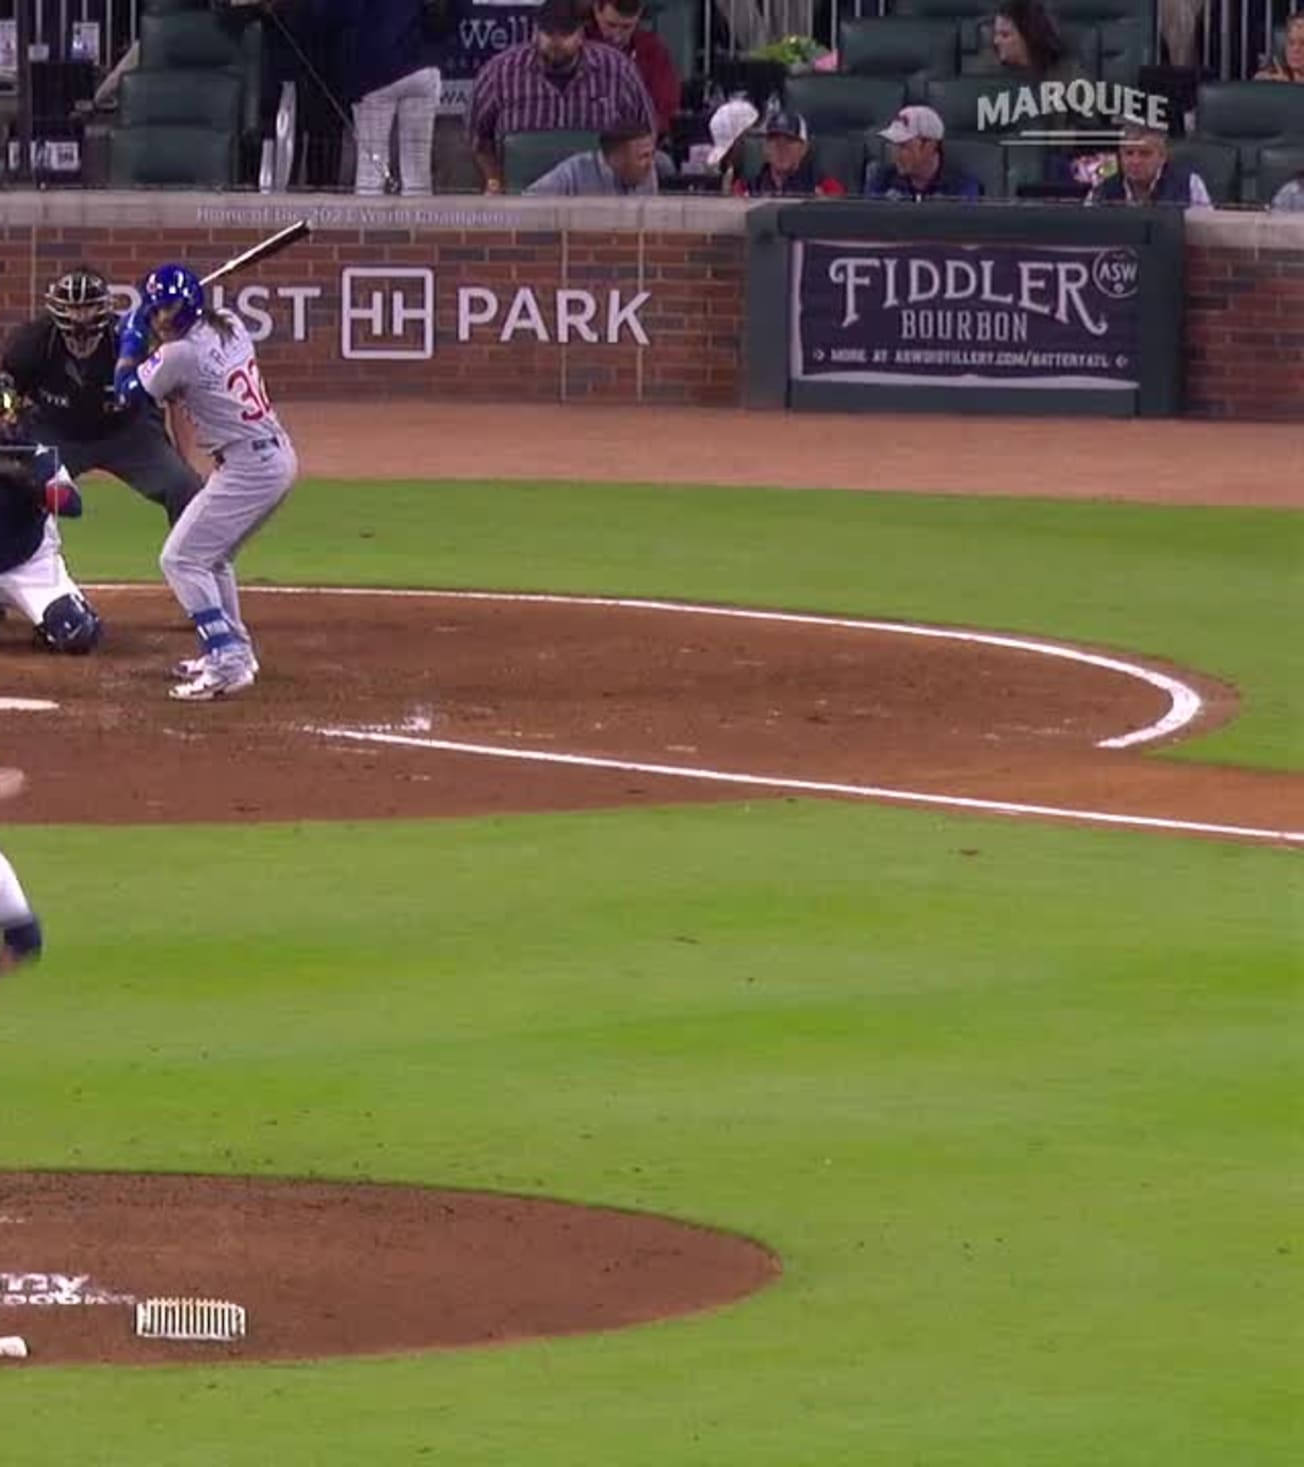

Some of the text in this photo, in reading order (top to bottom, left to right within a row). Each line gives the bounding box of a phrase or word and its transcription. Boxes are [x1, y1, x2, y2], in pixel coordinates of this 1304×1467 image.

[459, 16, 534, 49] Well
[1099, 262, 1138, 282] ASW
[829, 257, 1108, 336] FIDDLER
[458, 287, 652, 345] PARK
[901, 310, 1028, 342] BOURBON
